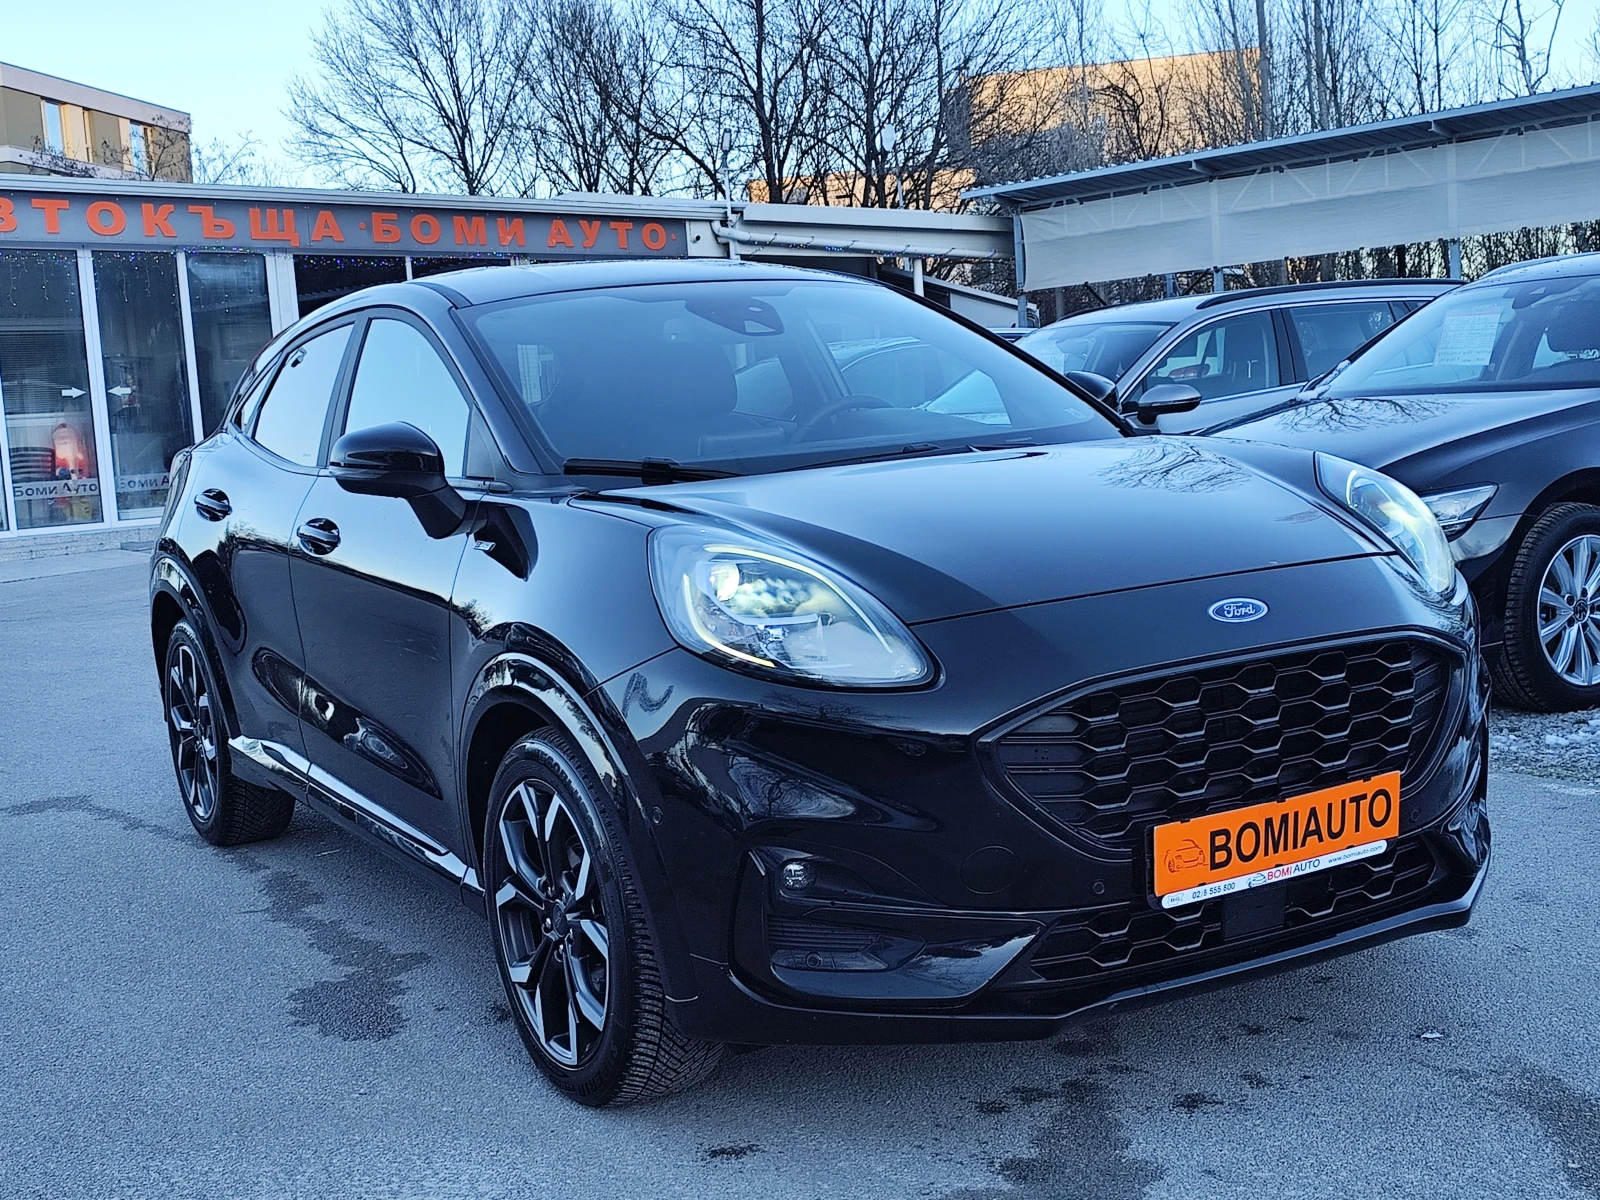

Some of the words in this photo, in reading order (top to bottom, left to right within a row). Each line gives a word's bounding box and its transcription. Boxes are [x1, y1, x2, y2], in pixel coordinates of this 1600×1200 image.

[371, 211, 526, 246] БОМИ
[547, 219, 667, 250] АУТО
[14, 485, 58, 497] Боми
[1223, 602, 1255, 618] Ford
[1210, 788, 1392, 871] BOMIAUTO
[1209, 886, 1222, 896] 555
[1267, 866, 1293, 881] BOMI
[1293, 859, 1321, 873] AUTO
[1328, 844, 1383, 863] www.bomiauto.com
